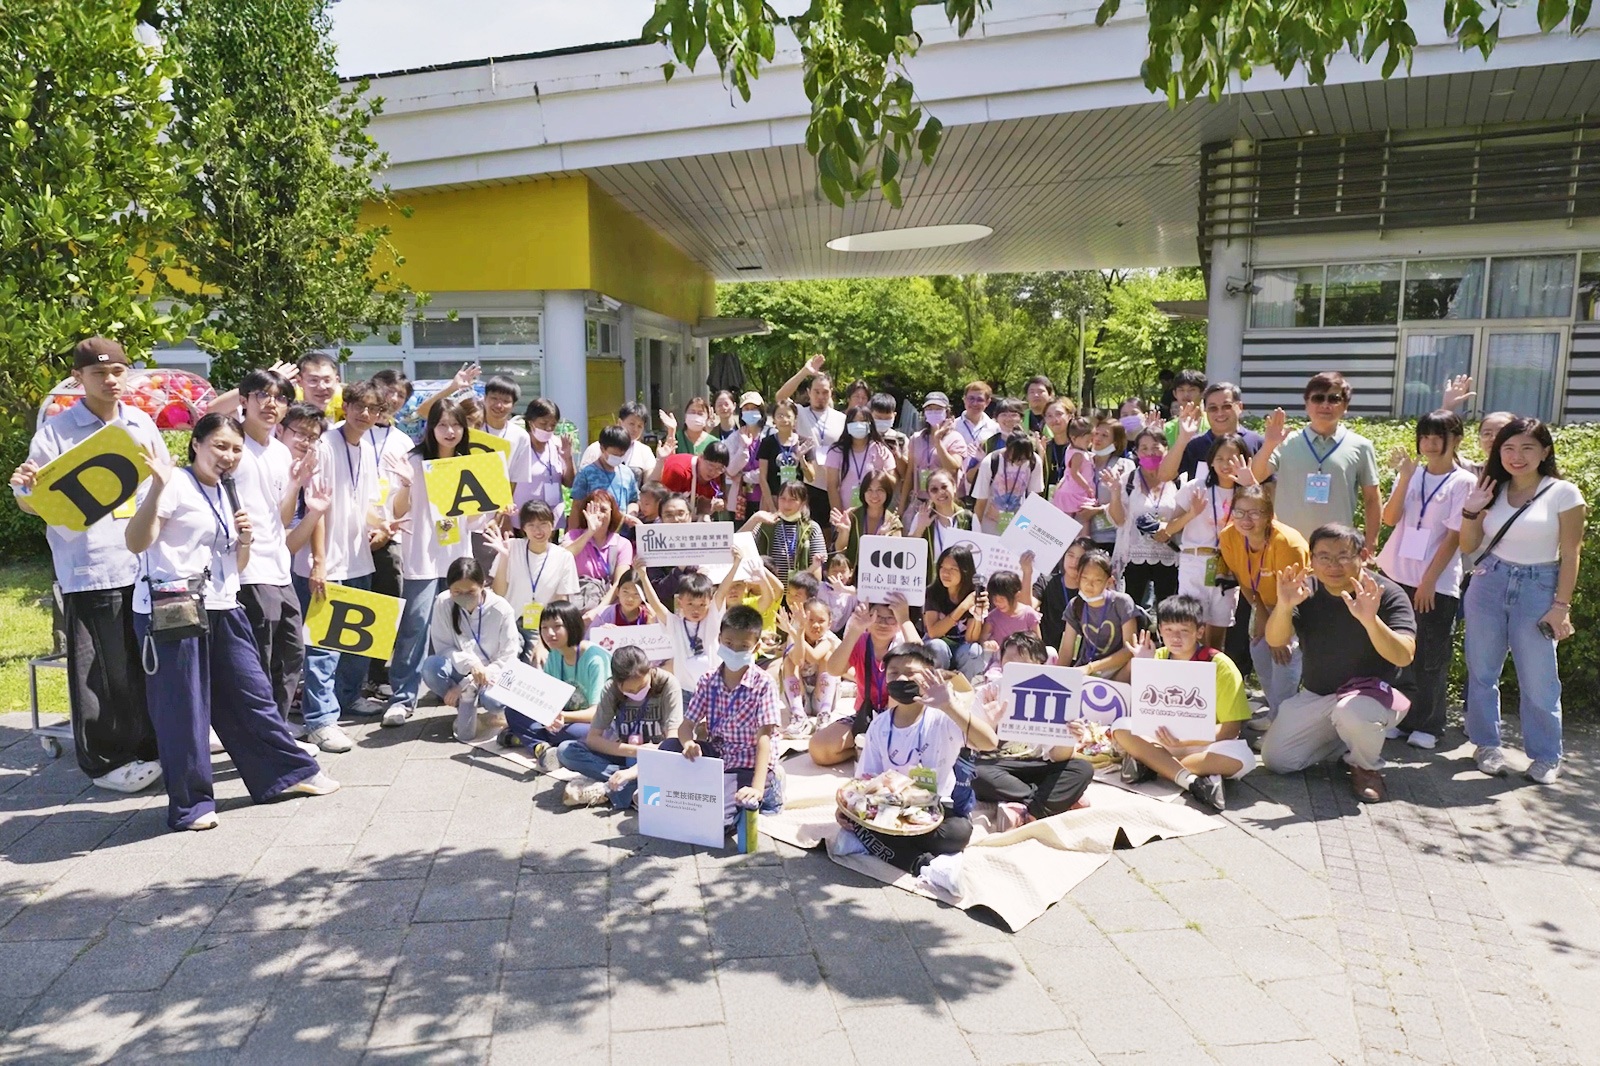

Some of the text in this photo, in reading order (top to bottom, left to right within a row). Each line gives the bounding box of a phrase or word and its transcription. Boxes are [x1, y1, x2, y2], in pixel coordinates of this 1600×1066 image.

[49, 453, 139, 526] D
[446, 469, 500, 517] A
[318, 599, 376, 652] B
